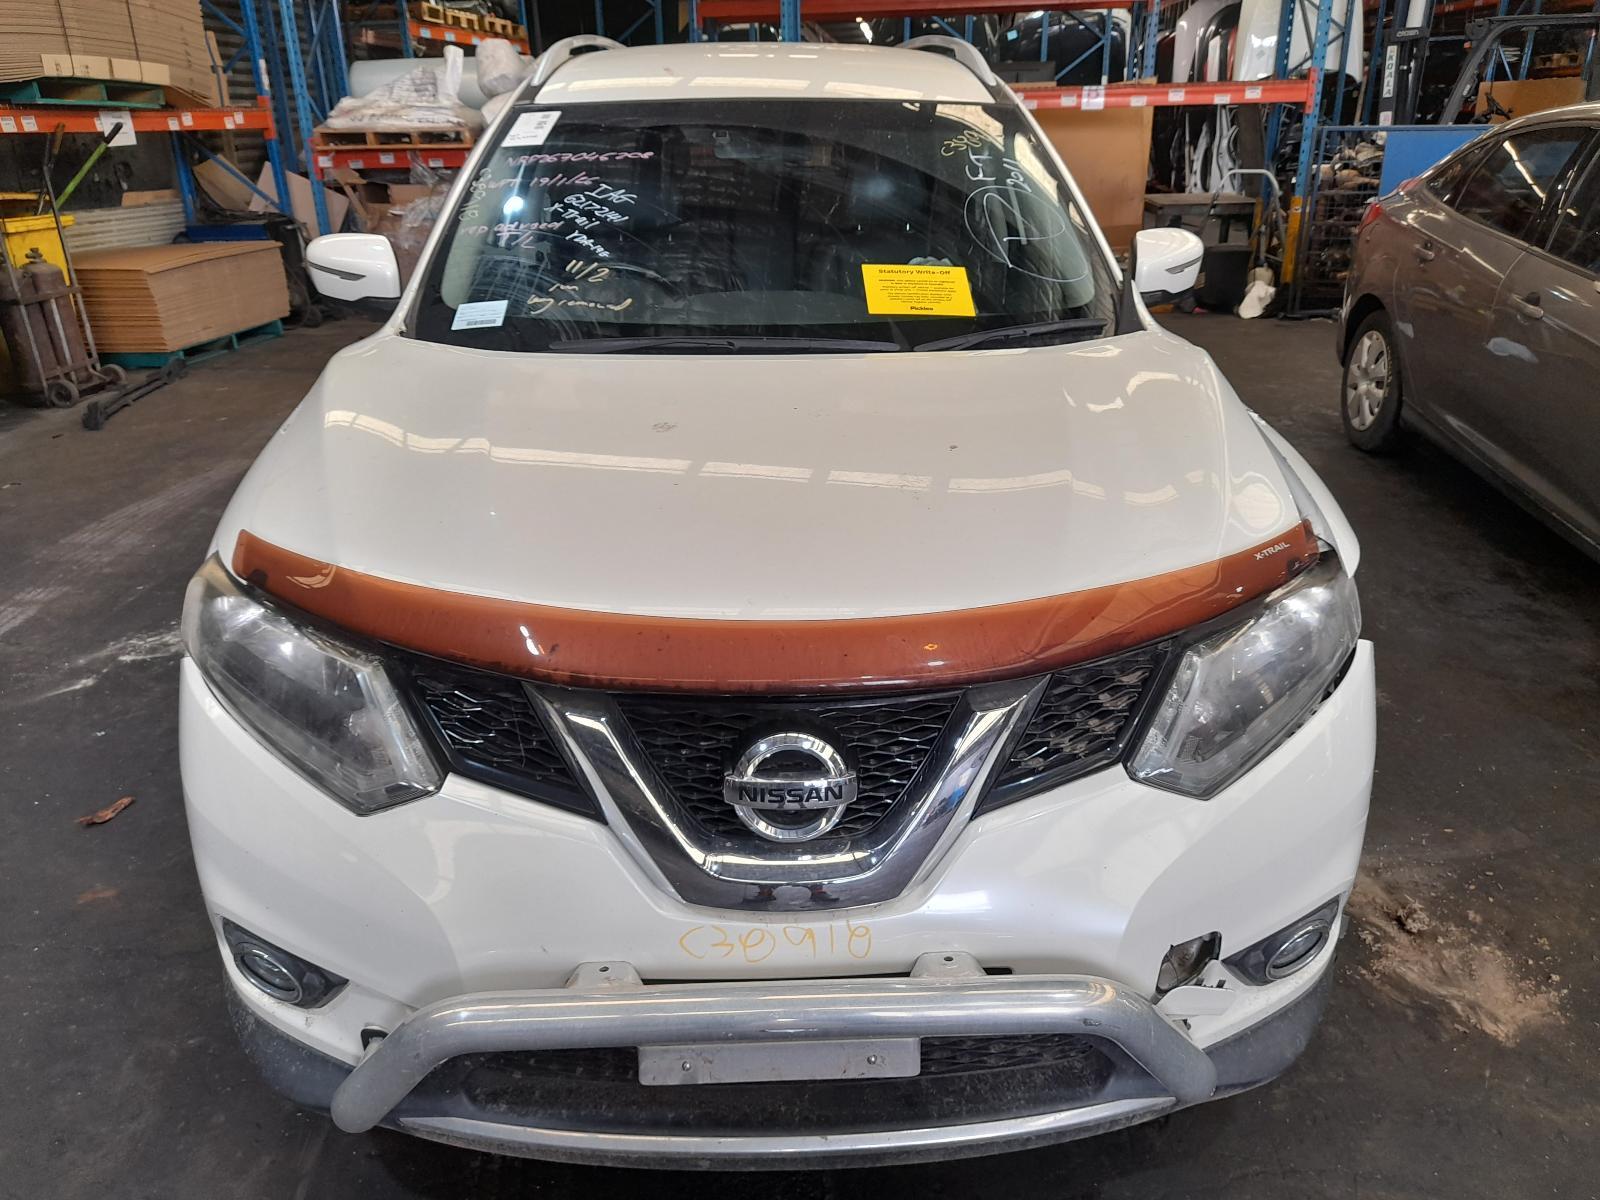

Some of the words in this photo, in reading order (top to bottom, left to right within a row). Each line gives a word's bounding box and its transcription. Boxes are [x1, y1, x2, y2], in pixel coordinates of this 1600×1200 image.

[565, 259, 610, 283] 11/2
[1254, 541, 1291, 561] X-TRAIL
[738, 785, 843, 804] NISSAN
